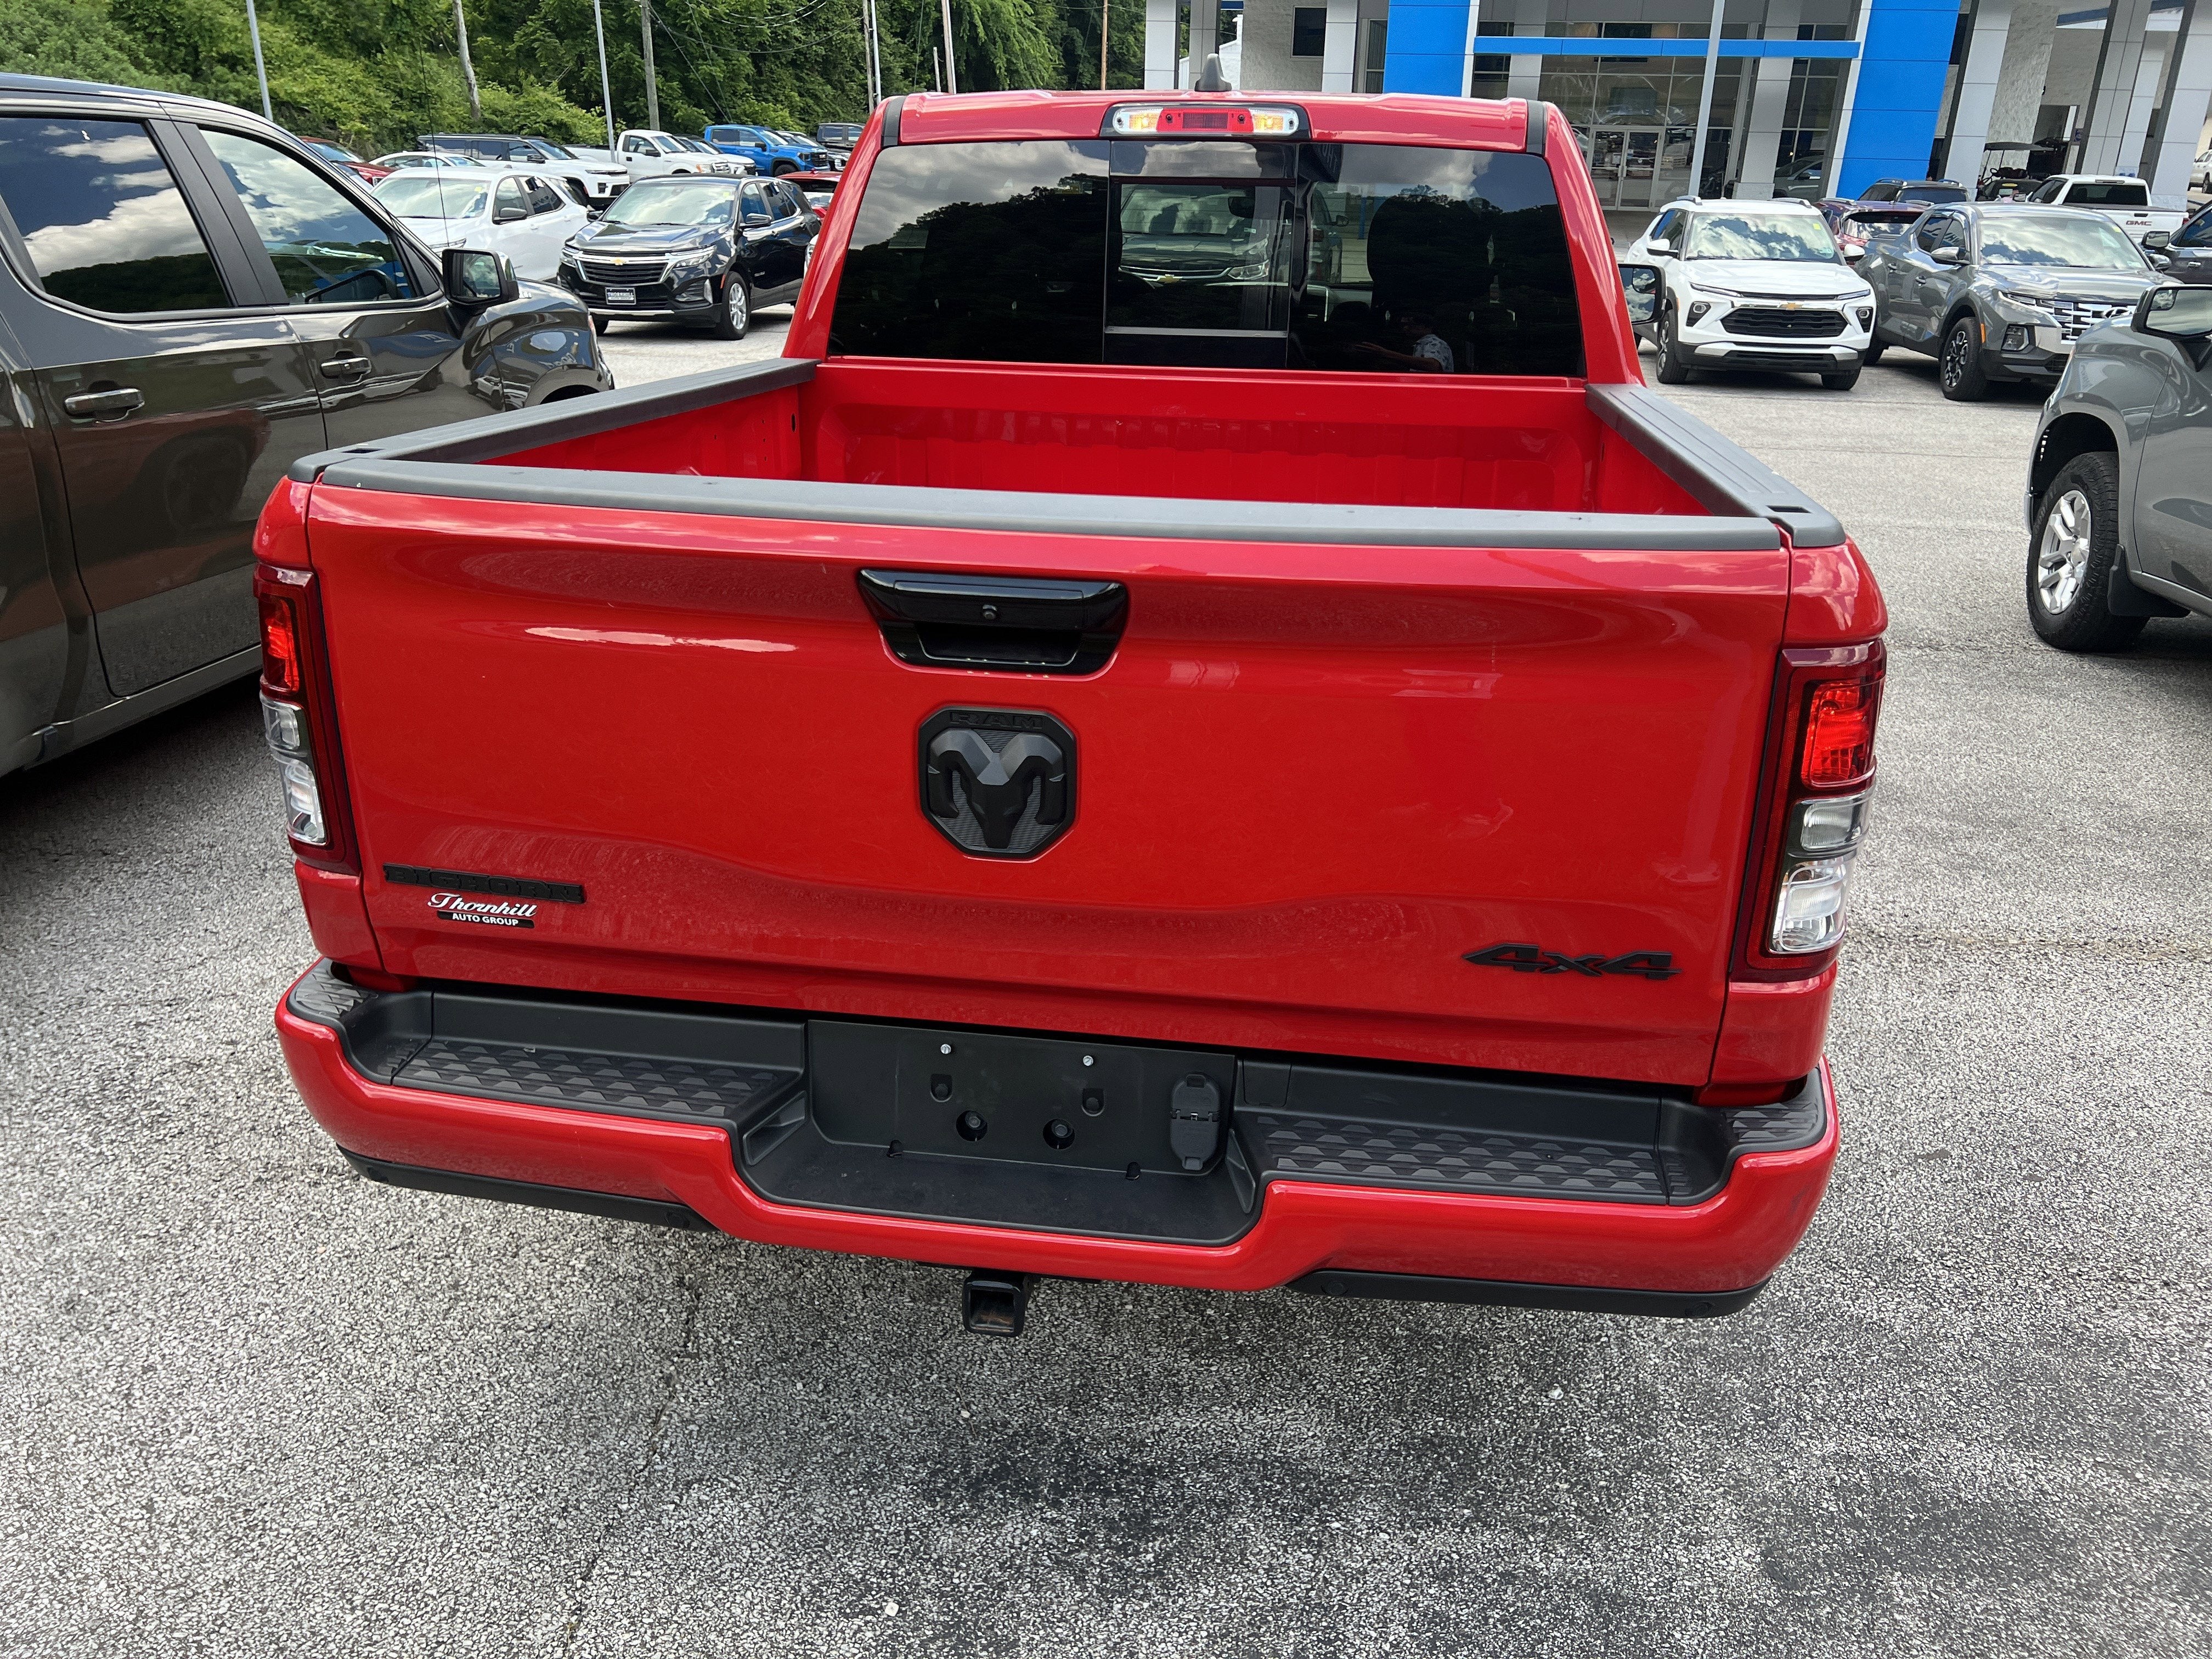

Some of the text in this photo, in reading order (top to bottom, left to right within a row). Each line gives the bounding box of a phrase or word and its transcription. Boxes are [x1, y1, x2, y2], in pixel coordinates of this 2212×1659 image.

[950, 712, 1043, 729] RAM
[427, 892, 537, 917] Thornhill
[452, 913, 518, 926] AUTO GROUP
